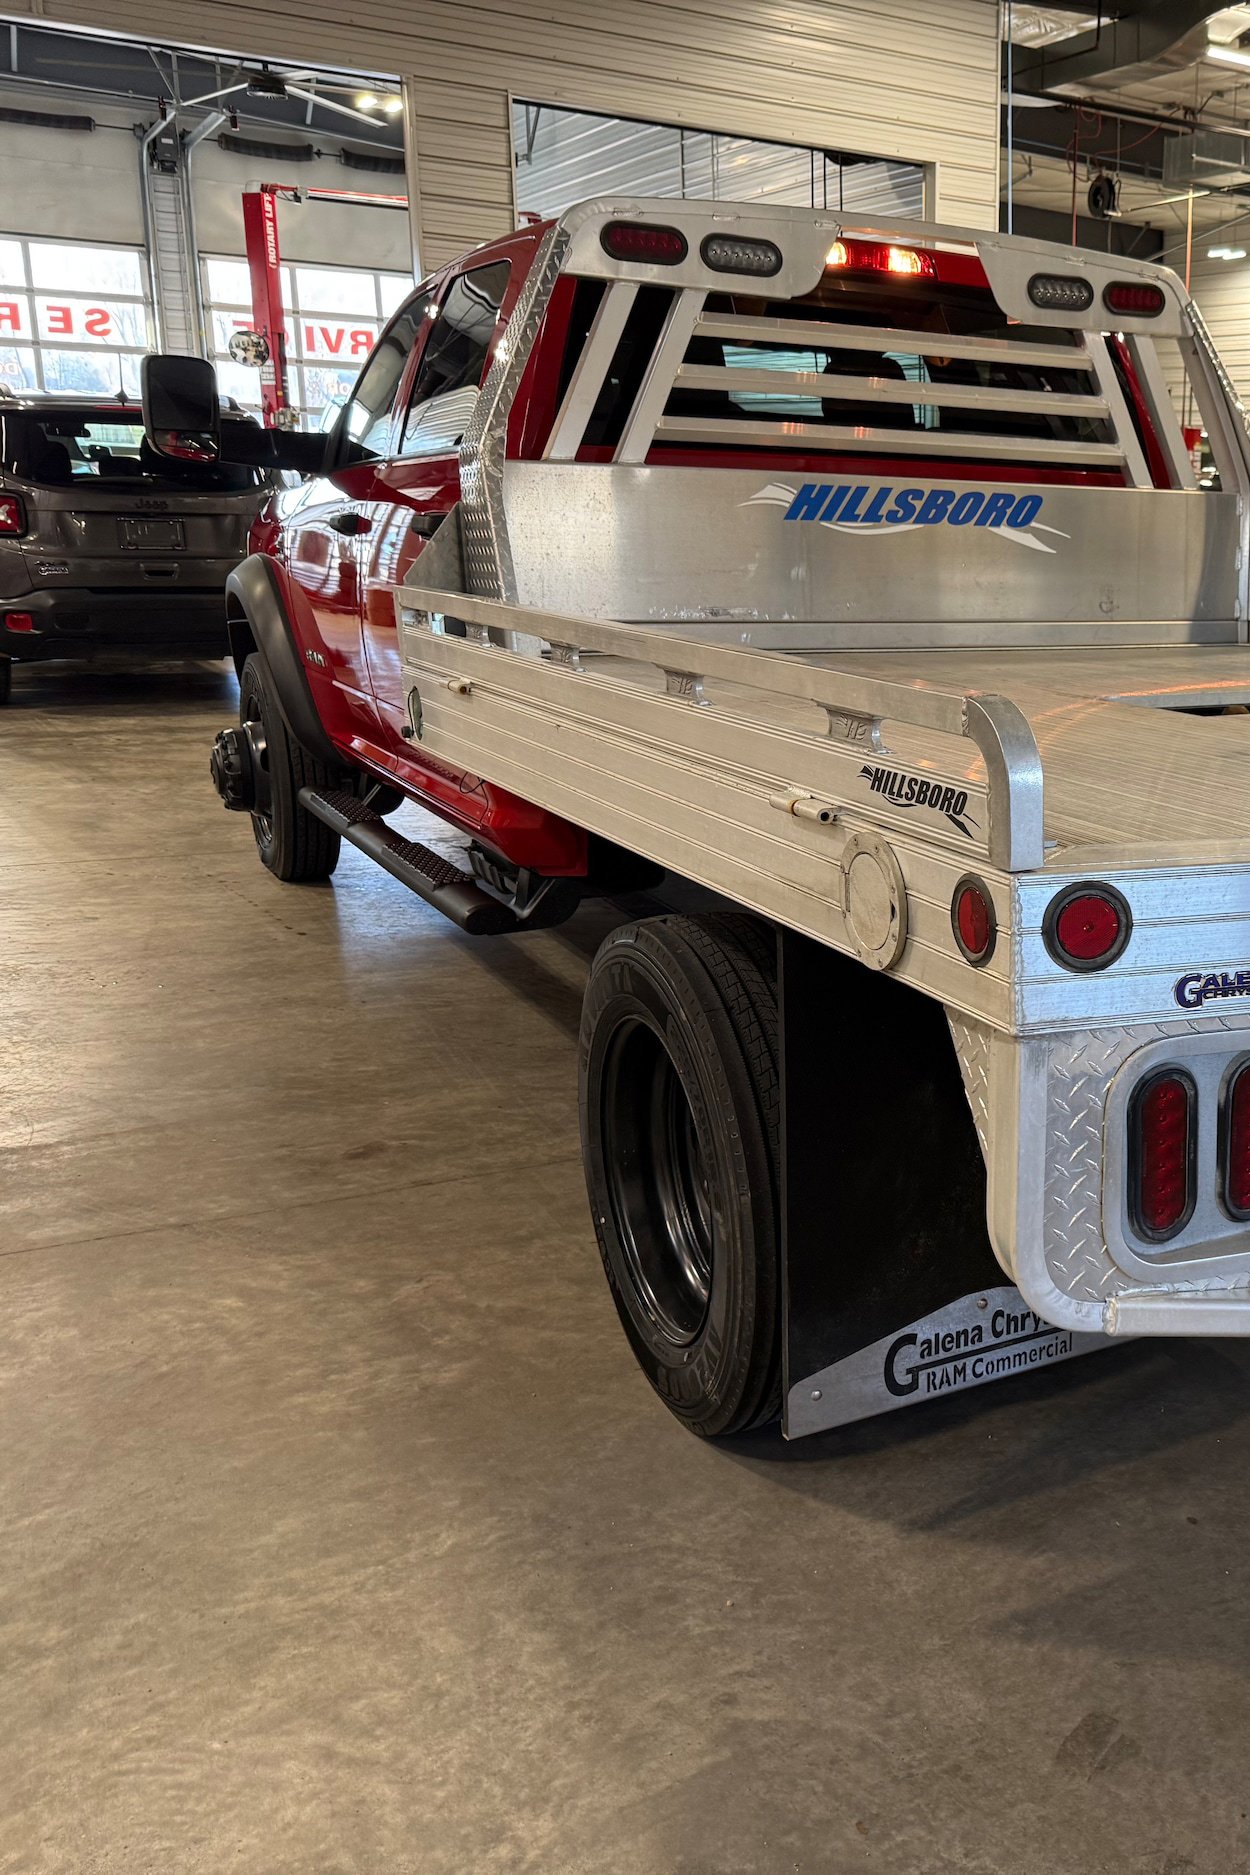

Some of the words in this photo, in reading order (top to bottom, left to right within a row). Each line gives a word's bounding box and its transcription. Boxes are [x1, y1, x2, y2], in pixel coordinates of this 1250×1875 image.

[263, 193, 274, 219] LIFT
[266, 219, 278, 263] ROTARY
[783, 484, 1043, 528] HILLSBORO
[870, 767, 968, 816] HILLSBORO
[884, 1324, 983, 1397] Galena
[991, 1309, 1050, 1339] Chry
[926, 1361, 967, 1393] RAM
[971, 1332, 1073, 1379] Commercial
